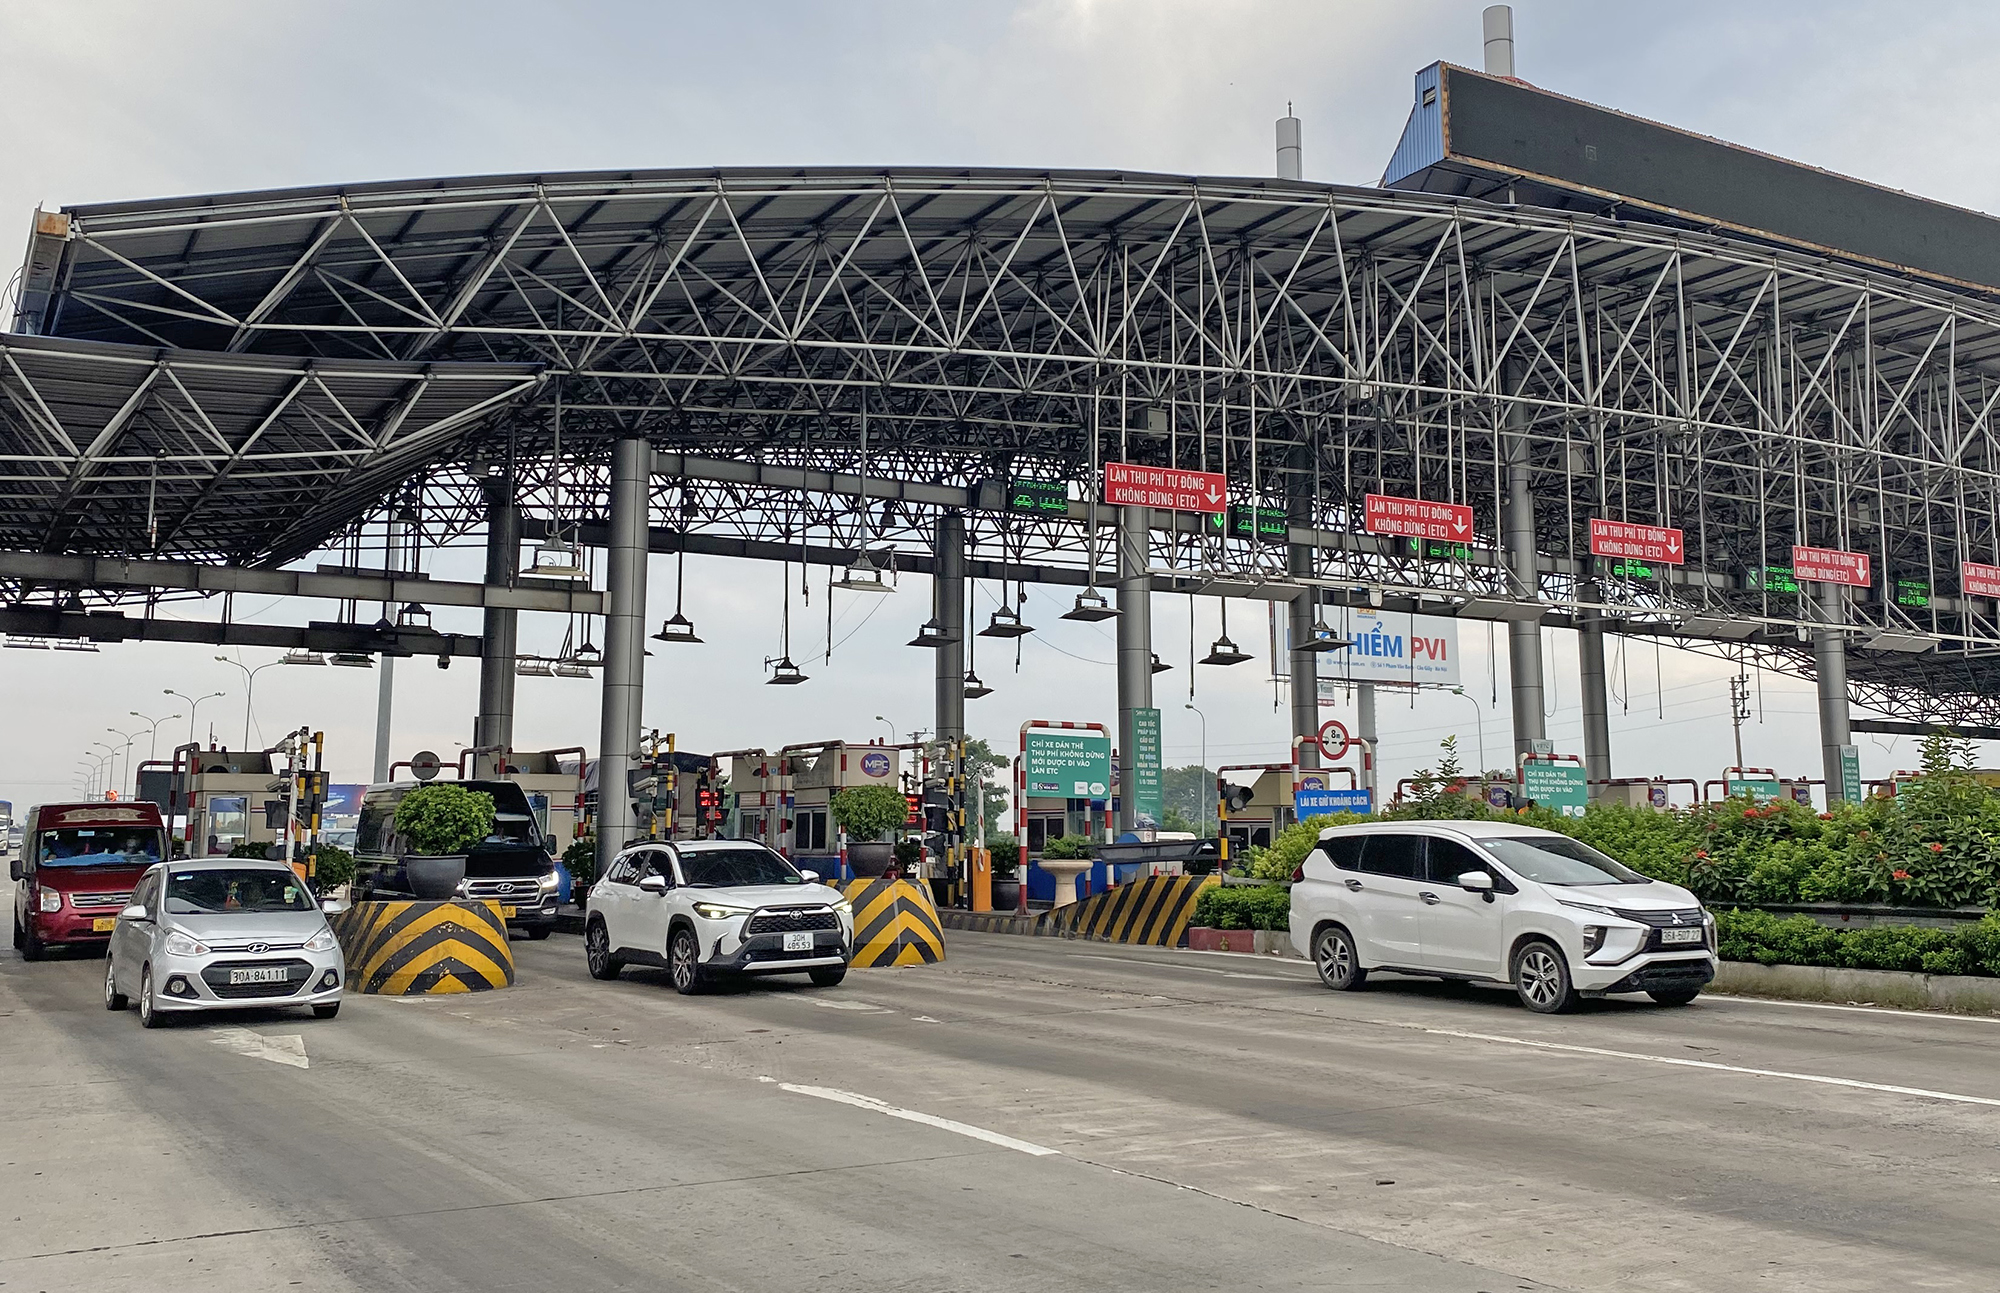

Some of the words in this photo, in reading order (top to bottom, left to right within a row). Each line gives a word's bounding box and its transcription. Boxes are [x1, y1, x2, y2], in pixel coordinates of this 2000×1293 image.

[1110, 466, 1127, 482] LÀN
[1130, 470, 1147, 484] THU
[1150, 471, 1165, 486] PHÍ
[1166, 474, 1179, 490] TỰ
[1181, 474, 1204, 491] ĐỘNG
[1116, 487, 1146, 503] KHÔNG
[1149, 489, 1173, 506] DỪNG
[1176, 494, 1200, 509] (ETC)
[1370, 498, 1385, 513] LÀN
[1387, 502, 1402, 515] THU
[1404, 502, 1418, 517] PHÍ
[1419, 505, 1429, 521] TỰ
[1431, 506, 1452, 522] ĐỘNG
[1375, 517, 1402, 533] KHÔNG
[1404, 519, 1425, 535] DỪNG
[1428, 523, 1448, 538] (ETC)
[1594, 522, 1608, 536] LÀN
[1609, 525, 1622, 537] THU
[1624, 525, 1636, 539] PHÍ
[1637, 528, 1647, 542] TỰ
[1648, 528, 1666, 543] ĐỘNG
[1599, 540, 1622, 553] KHÔNG
[1624, 541, 1643, 556] DỪNG
[1645, 545, 1663, 558] (ETC)
[1809, 551, 1819, 562] THU
[1820, 551, 1830, 564] PHÍ
[1840, 554, 1856, 568] ĐỘNG
[1796, 565, 1816, 577] KHÔNG
[1976, 567, 1986, 578] THU
[1969, 580, 1986, 592] KHÔNG
[1348, 621, 1403, 658] HIỂM
[1412, 636, 1446, 660] PVI
[1031, 739, 1044, 748] CHỈ
[1056, 740, 1069, 748] DÁN
[1086, 751, 1105, 759] DỪNG
[865, 760, 888, 768] MPC
[1047, 759, 1066, 768] ĐƯỢC
[1032, 766, 1045, 774] LÀN
[1300, 795, 1309, 806] LÁI
[1310, 797, 1318, 806] XE
[1329, 793, 1352, 806] KHOẢNG
[1353, 794, 1368, 806] CÁCH
[233, 970, 284, 982] 30A-841.11
